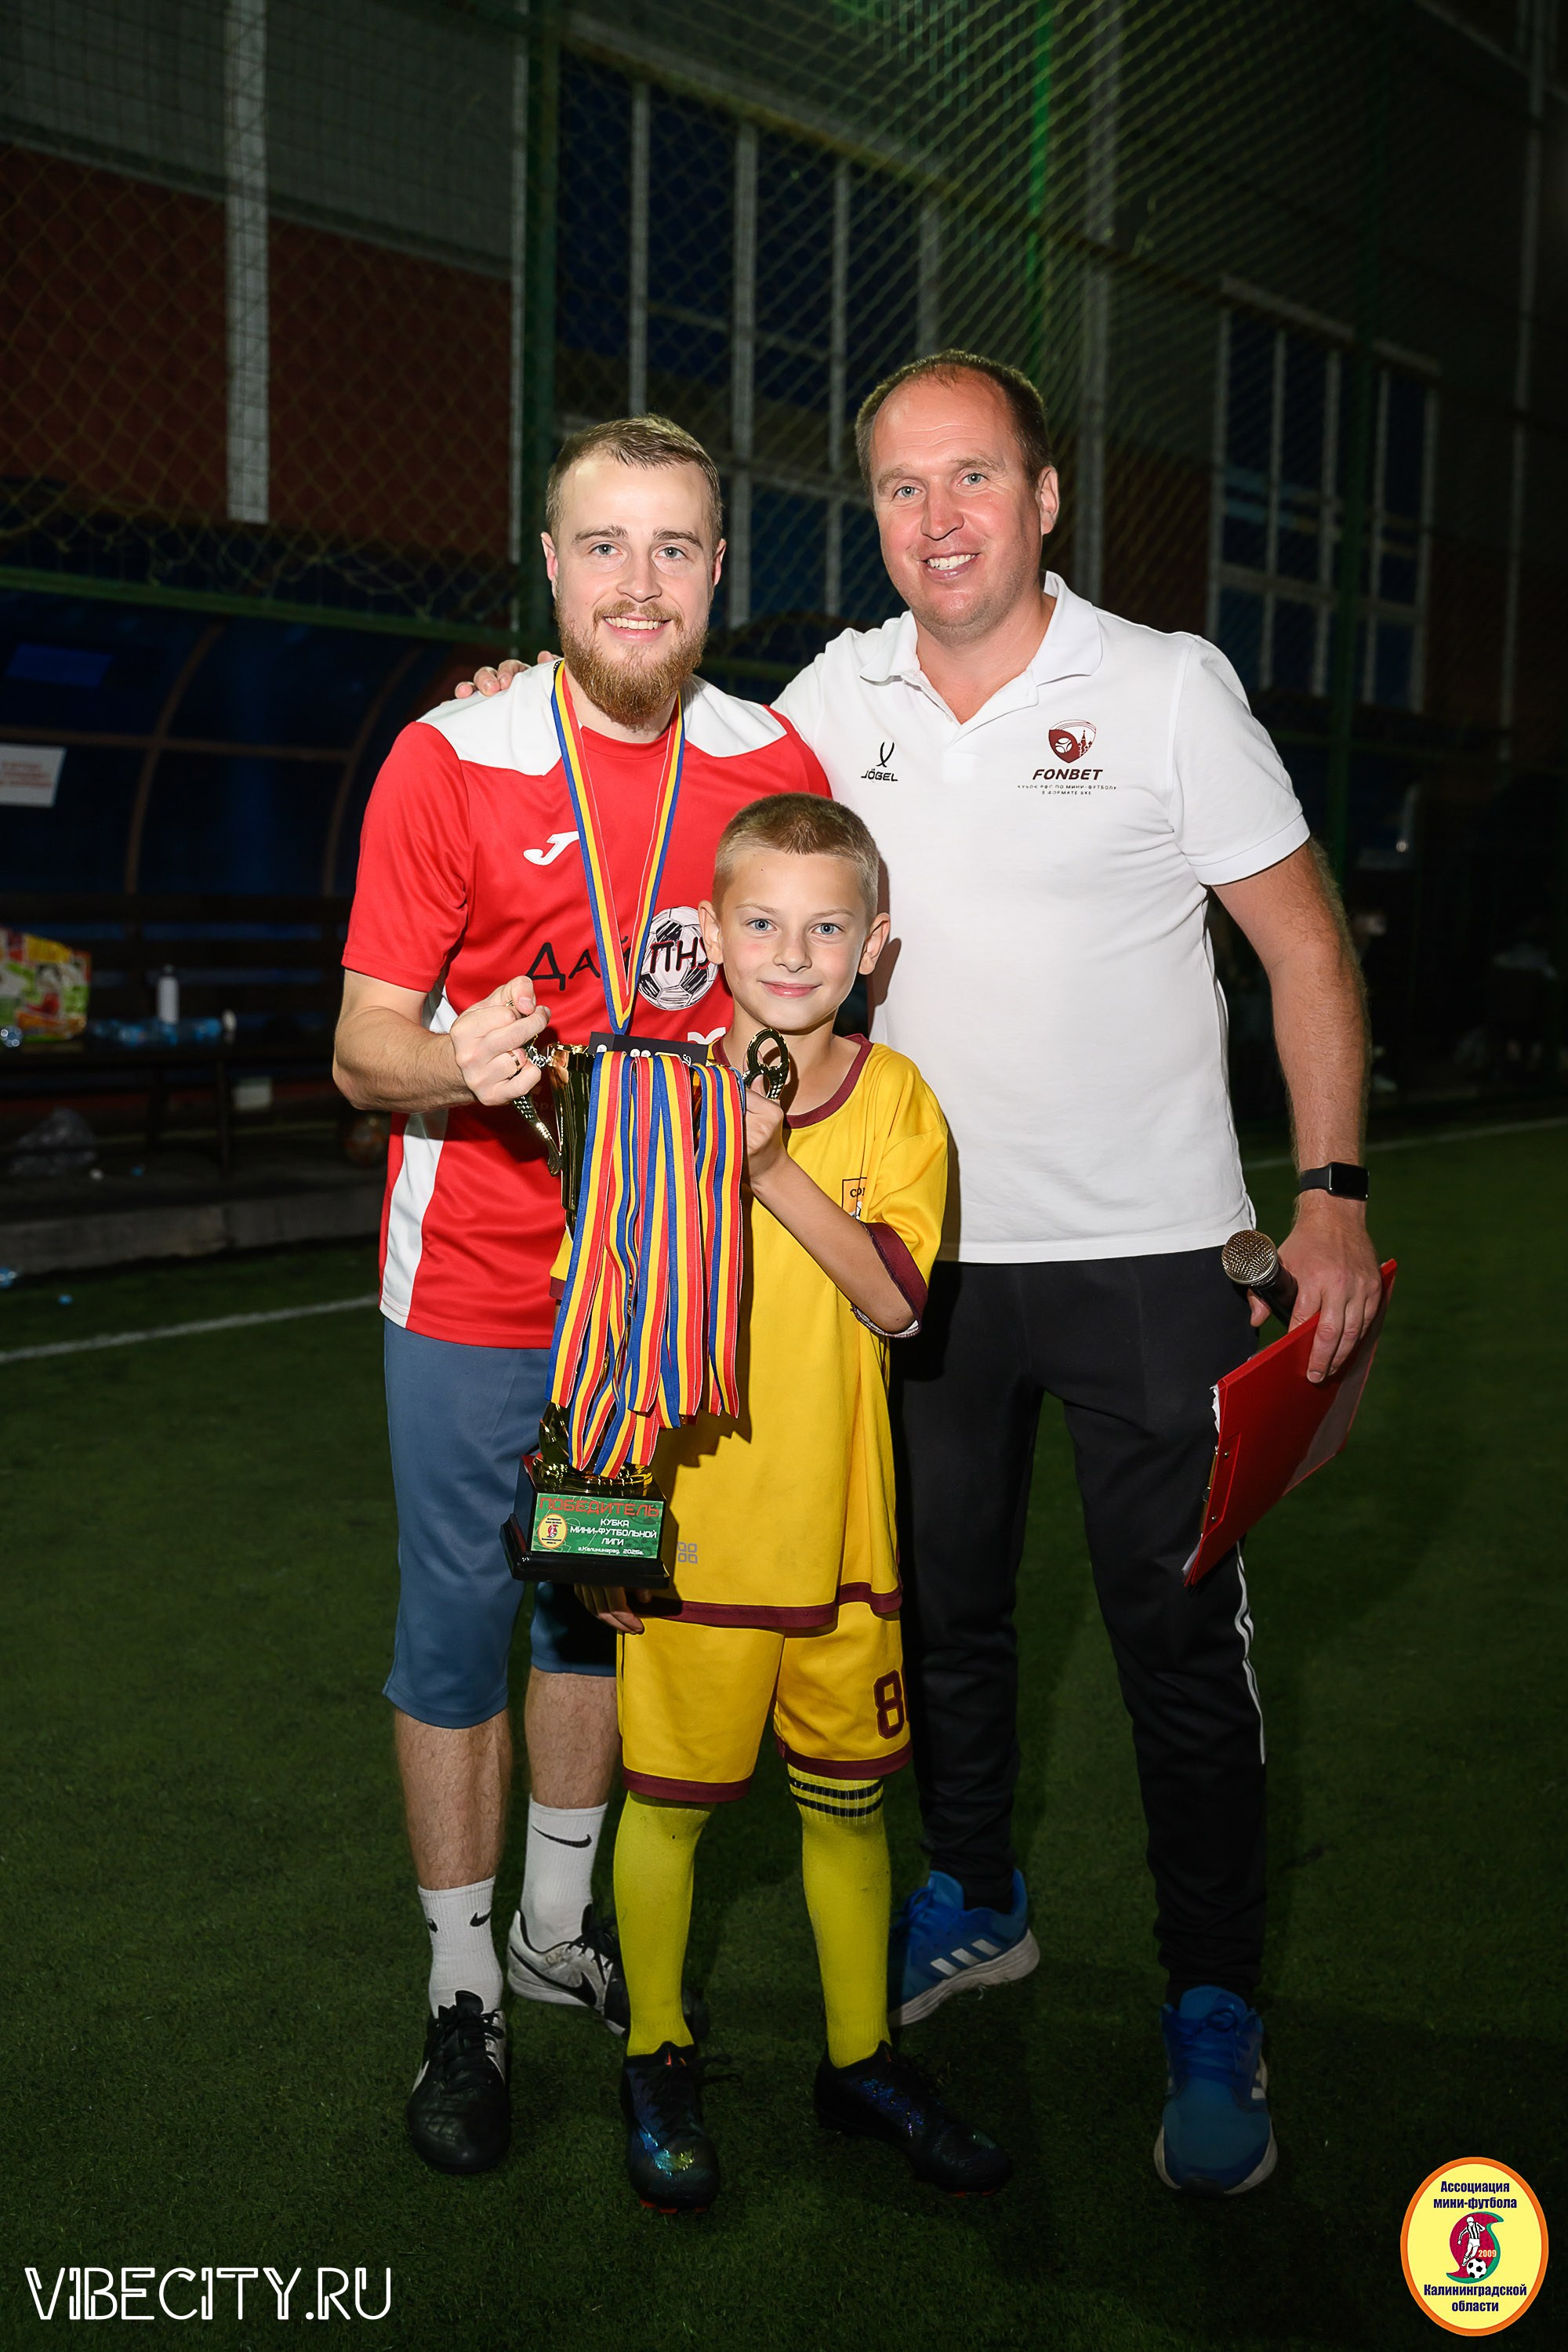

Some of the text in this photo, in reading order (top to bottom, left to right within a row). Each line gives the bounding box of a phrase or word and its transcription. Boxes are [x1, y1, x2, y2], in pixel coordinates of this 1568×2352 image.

[861, 768, 898, 782] JÖGEL
[1032, 768, 1103, 780] FONBET
[539, 1497, 659, 1517] ПОБЕДИТЕЛЬ
[600, 1518, 630, 1527] КУБКА
[570, 1526, 657, 1539] МИНИ-ФУТБОЛЬНОЙ
[601, 1537, 624, 1546] ЛИГИ
[873, 1669, 906, 1740] 8
